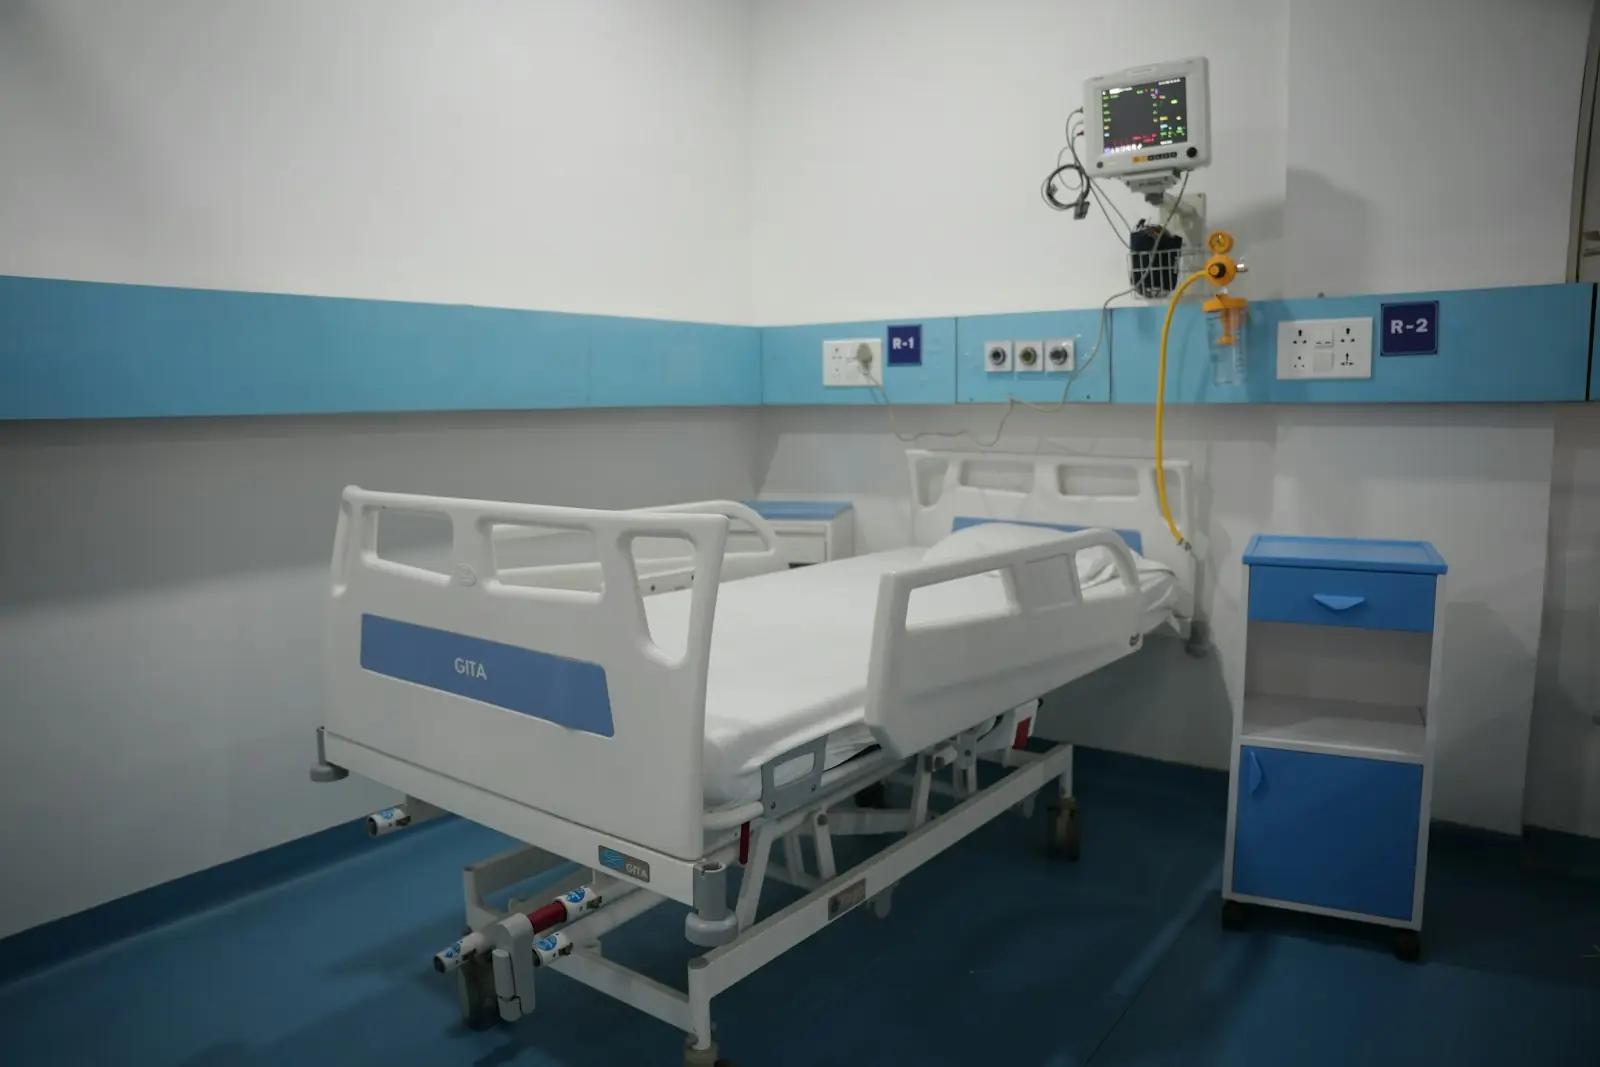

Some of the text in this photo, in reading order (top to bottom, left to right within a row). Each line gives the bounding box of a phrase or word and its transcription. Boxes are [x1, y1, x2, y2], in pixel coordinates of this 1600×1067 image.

[1391, 318, 1428, 334] R-2
[893, 337, 914, 350] R-1
[454, 657, 487, 681] GITA
